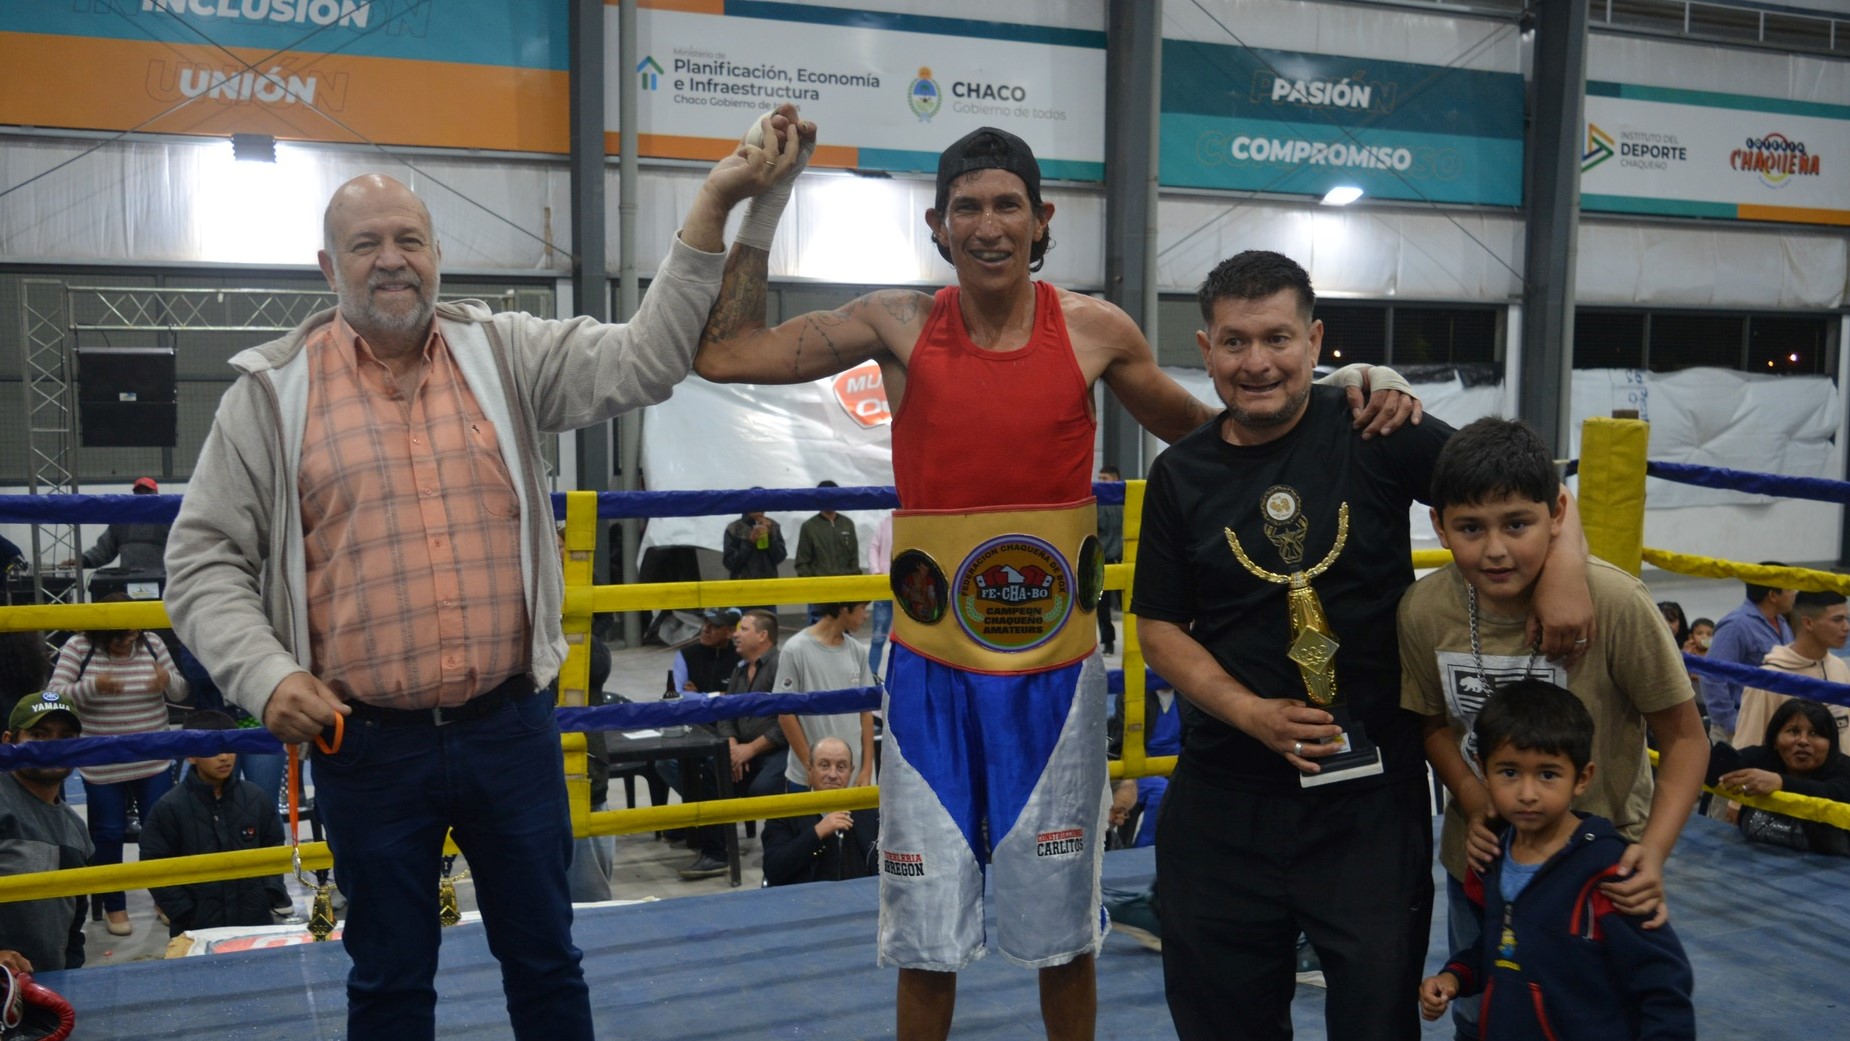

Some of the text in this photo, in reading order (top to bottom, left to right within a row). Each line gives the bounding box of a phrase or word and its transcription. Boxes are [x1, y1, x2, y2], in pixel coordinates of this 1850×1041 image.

[674, 59, 880, 88] Planificación, Economía
[178, 66, 318, 104] UNIÓN
[674, 78, 819, 100] e Infraestructura
[952, 81, 1026, 102] CHACO
[1271, 78, 1372, 109] PASIÓN
[673, 94, 707, 105] Chaco
[709, 96, 756, 109] Gobierno
[758, 99, 771, 110] de
[953, 101, 1067, 120] Gobierno de todos
[1620, 131, 1678, 144] INSTITUTO DEL
[1231, 135, 1412, 171] COMPROMISO
[1620, 143, 1687, 160] DEPORTE
[1056, 575, 1066, 593] BOX
[983, 626, 1043, 634] AMATEURS
[31, 702, 71, 712] YAMAHA
[1037, 838, 1083, 857] CARLITOS
